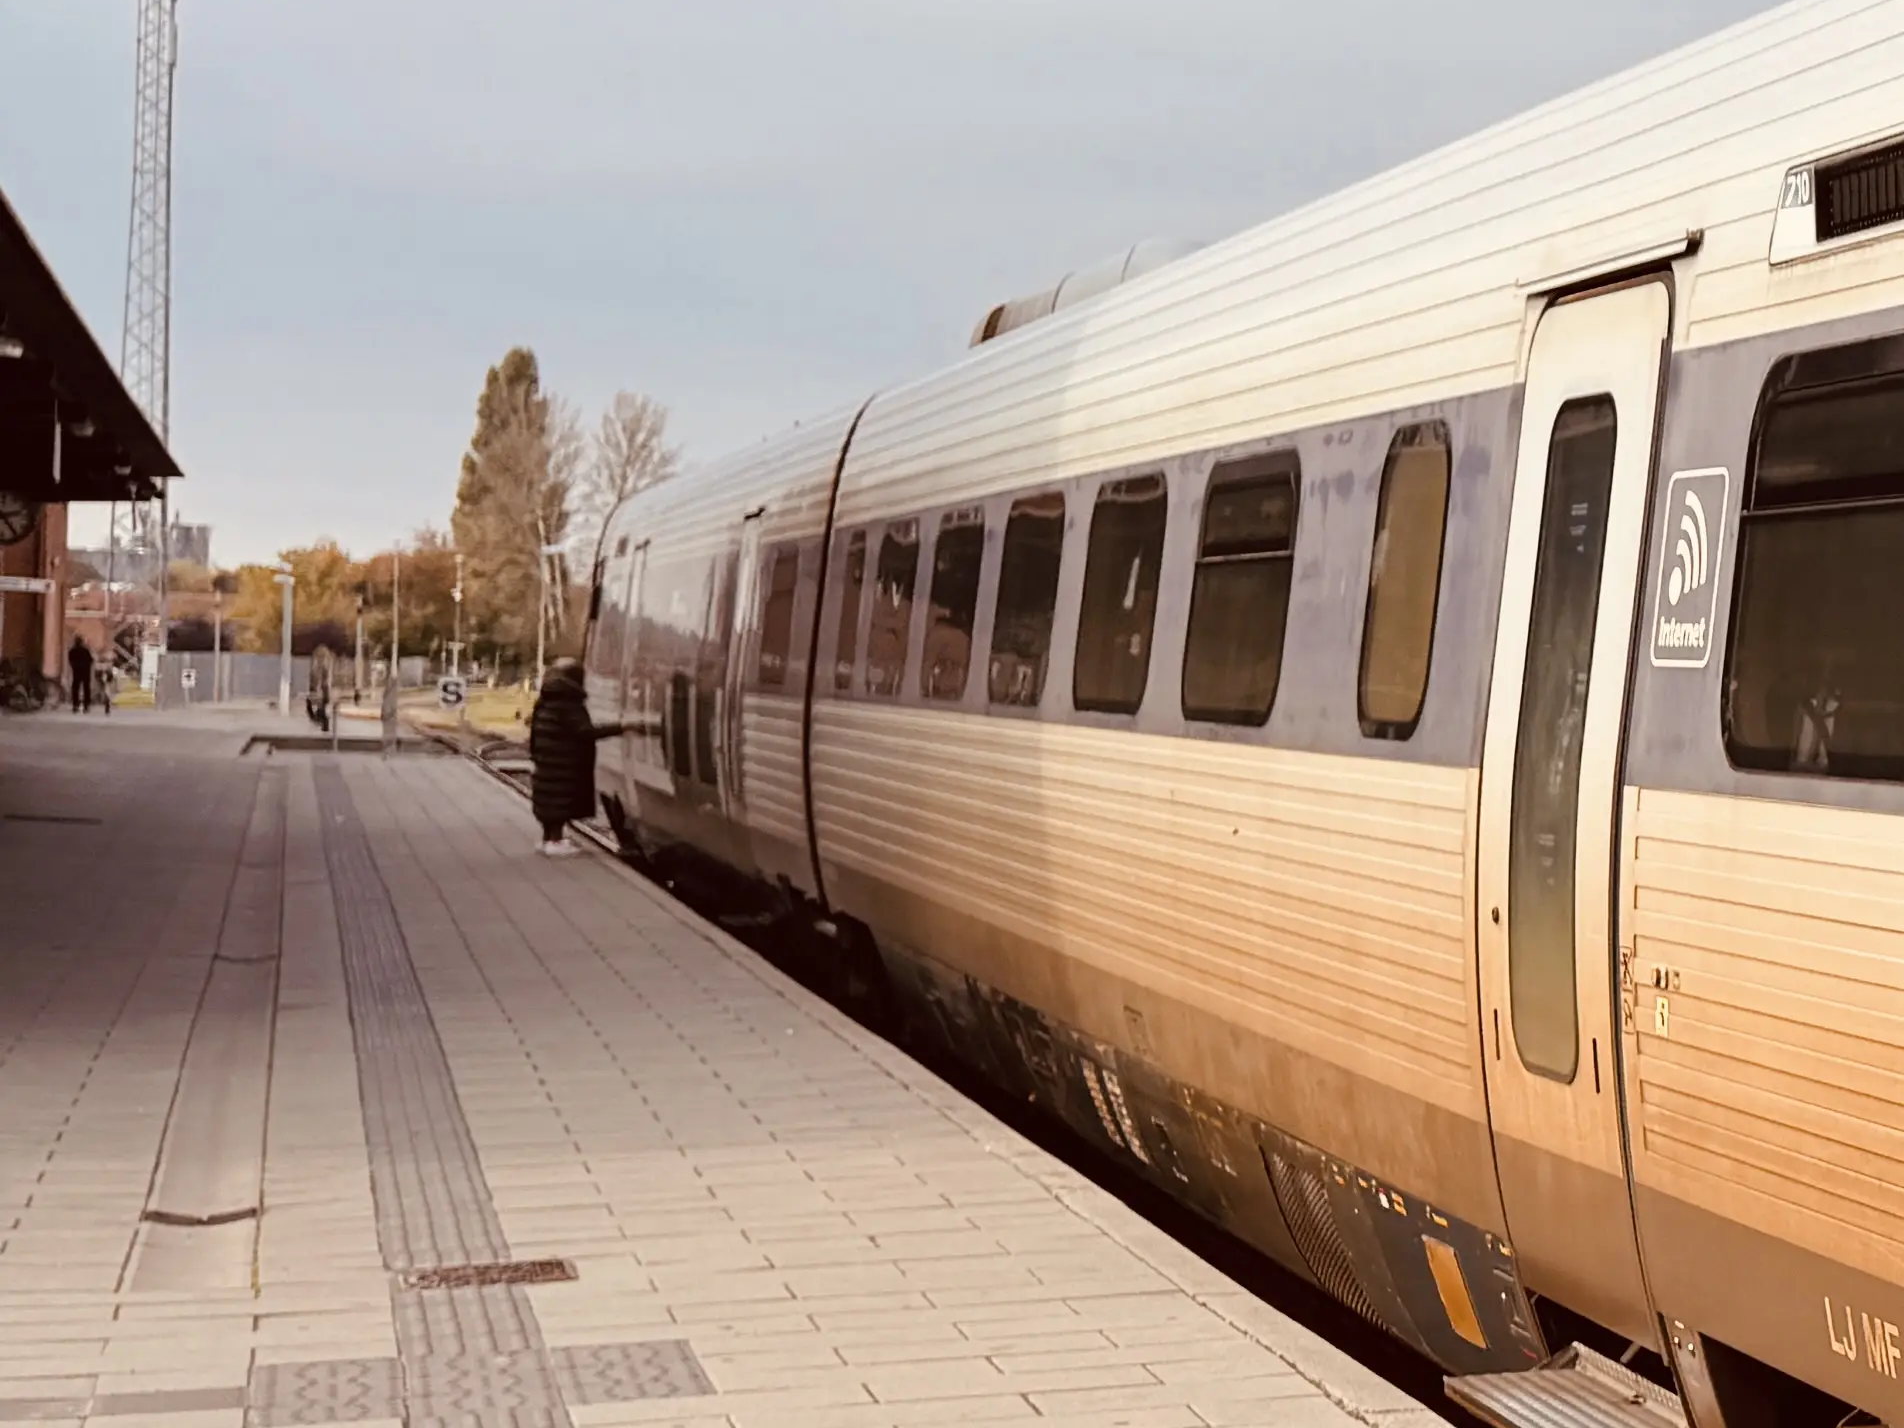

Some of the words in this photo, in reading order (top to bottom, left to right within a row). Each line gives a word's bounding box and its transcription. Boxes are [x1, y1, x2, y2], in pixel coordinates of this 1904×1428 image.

[1784, 171, 1811, 207] 710
[1658, 616, 1706, 648] Internet
[441, 680, 463, 705] S
[1824, 1296, 1857, 1361] LJ
[1861, 1312, 1902, 1380] MF
